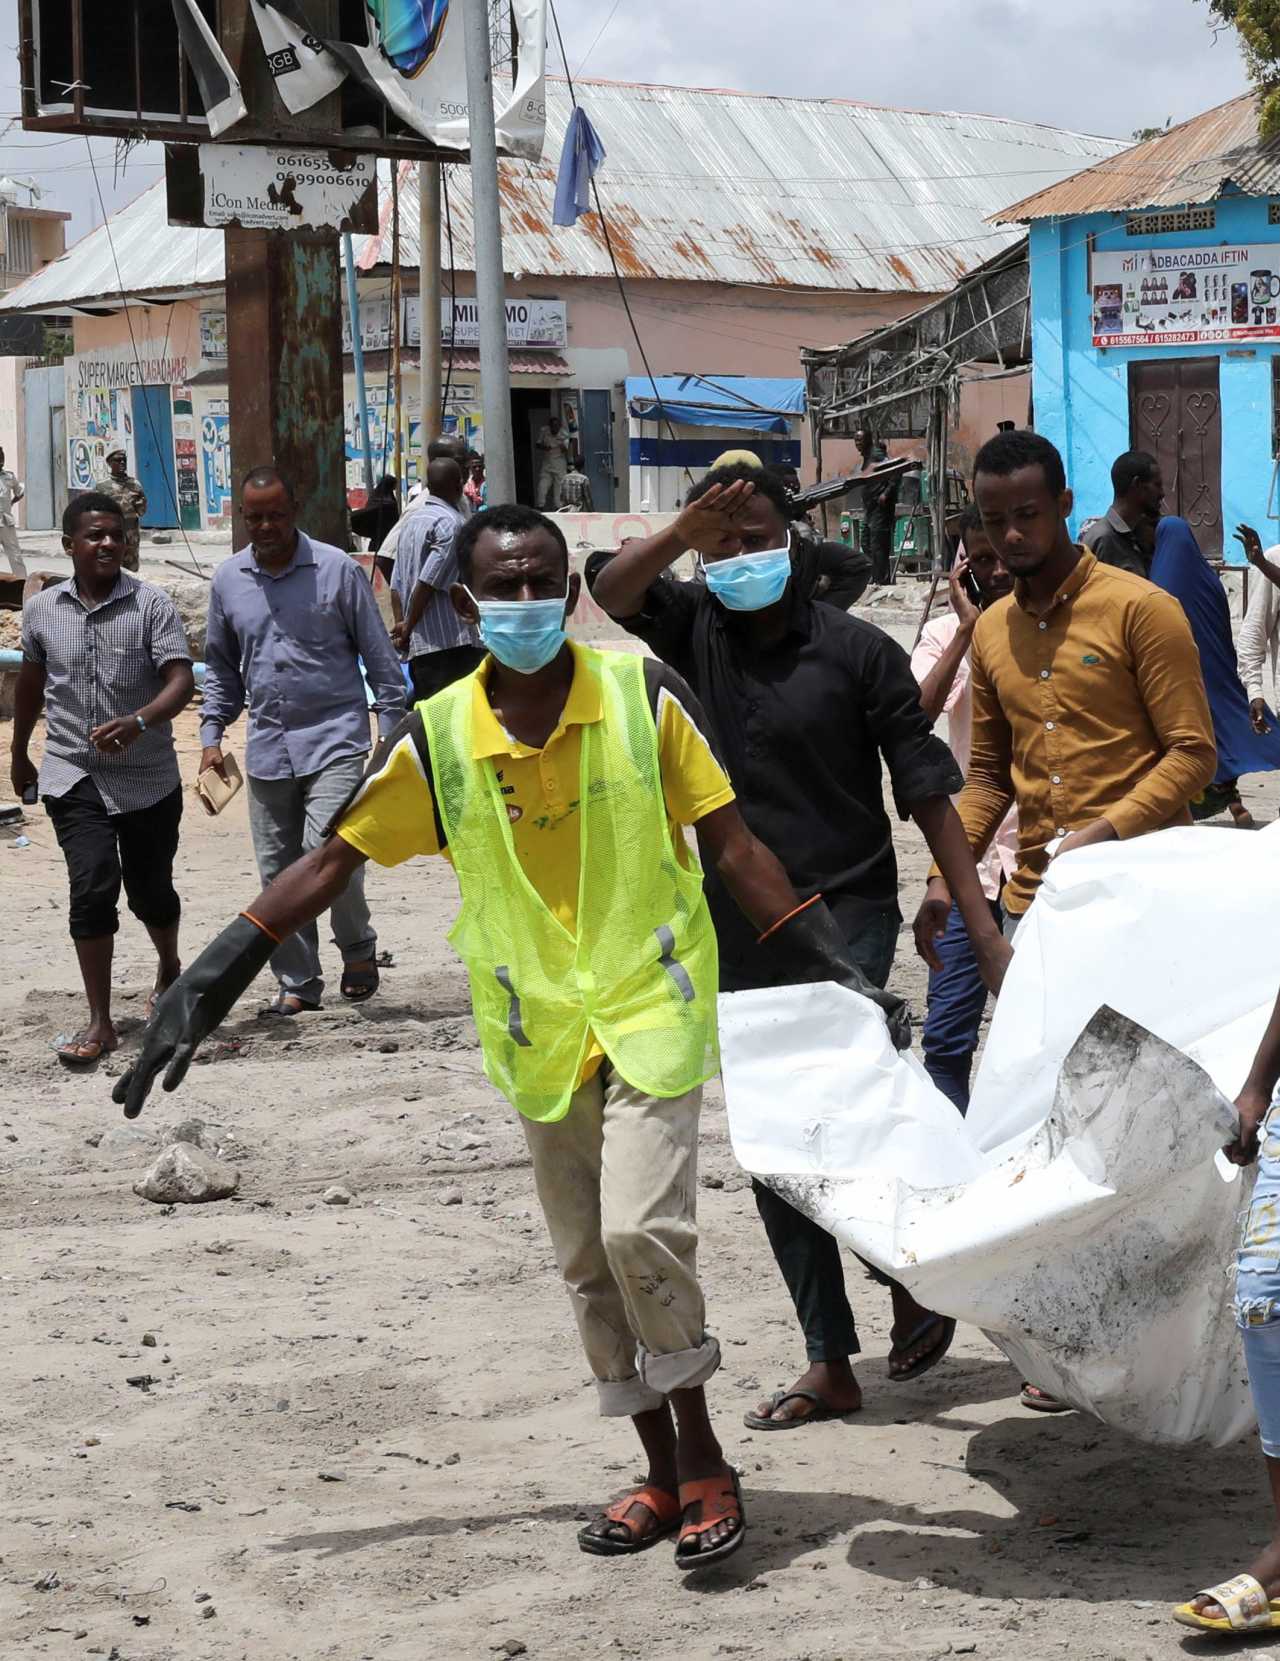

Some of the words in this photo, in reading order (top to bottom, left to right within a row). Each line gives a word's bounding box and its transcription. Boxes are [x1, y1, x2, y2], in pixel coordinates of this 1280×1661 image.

[211, 193, 243, 209] iCon
[1220, 250, 1249, 263] IFTIN
[78, 360, 143, 388] SUPERMARKET
